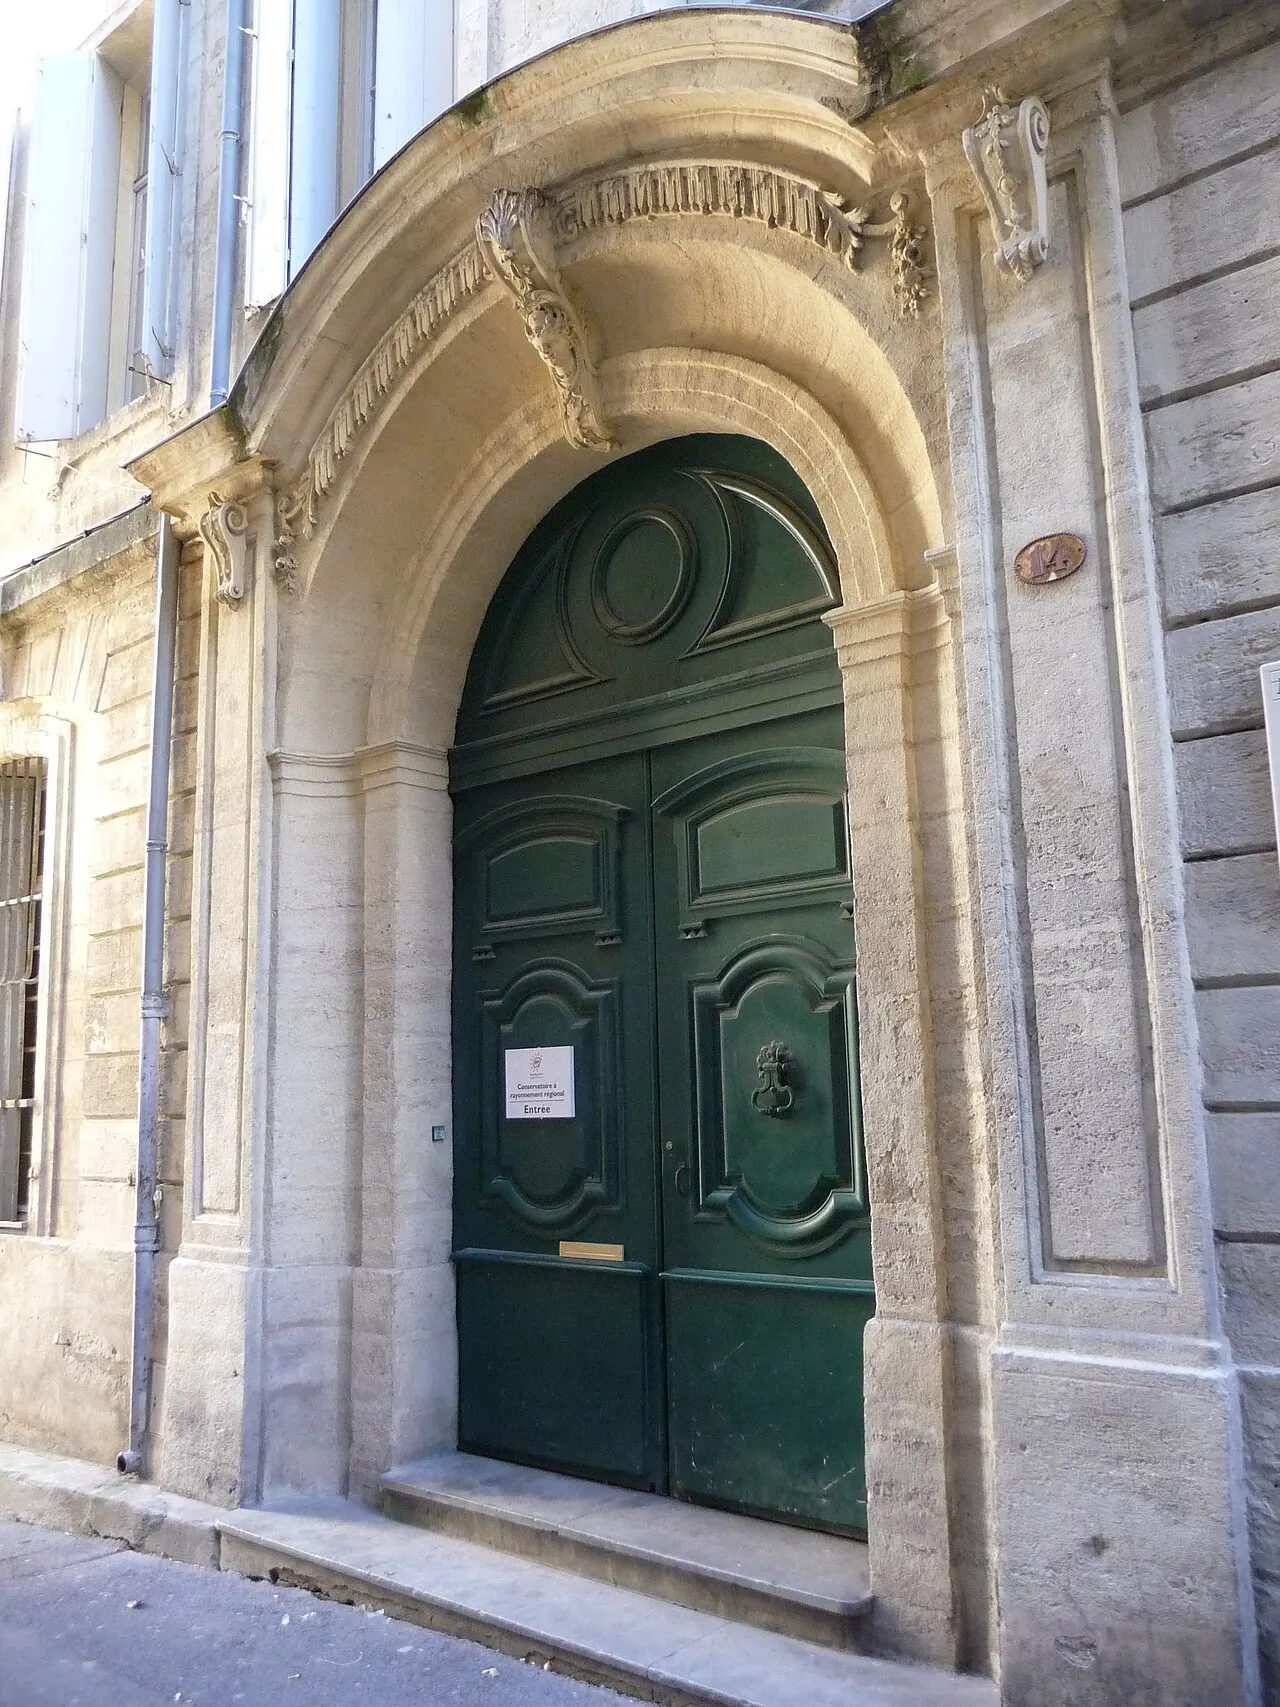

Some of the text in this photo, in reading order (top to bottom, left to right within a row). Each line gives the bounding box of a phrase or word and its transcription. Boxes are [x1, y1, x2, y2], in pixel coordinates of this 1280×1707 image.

[1030, 539, 1070, 578] 14
[510, 1090, 565, 1100] rayonnement régional
[524, 1104, 551, 1114] Entrée
